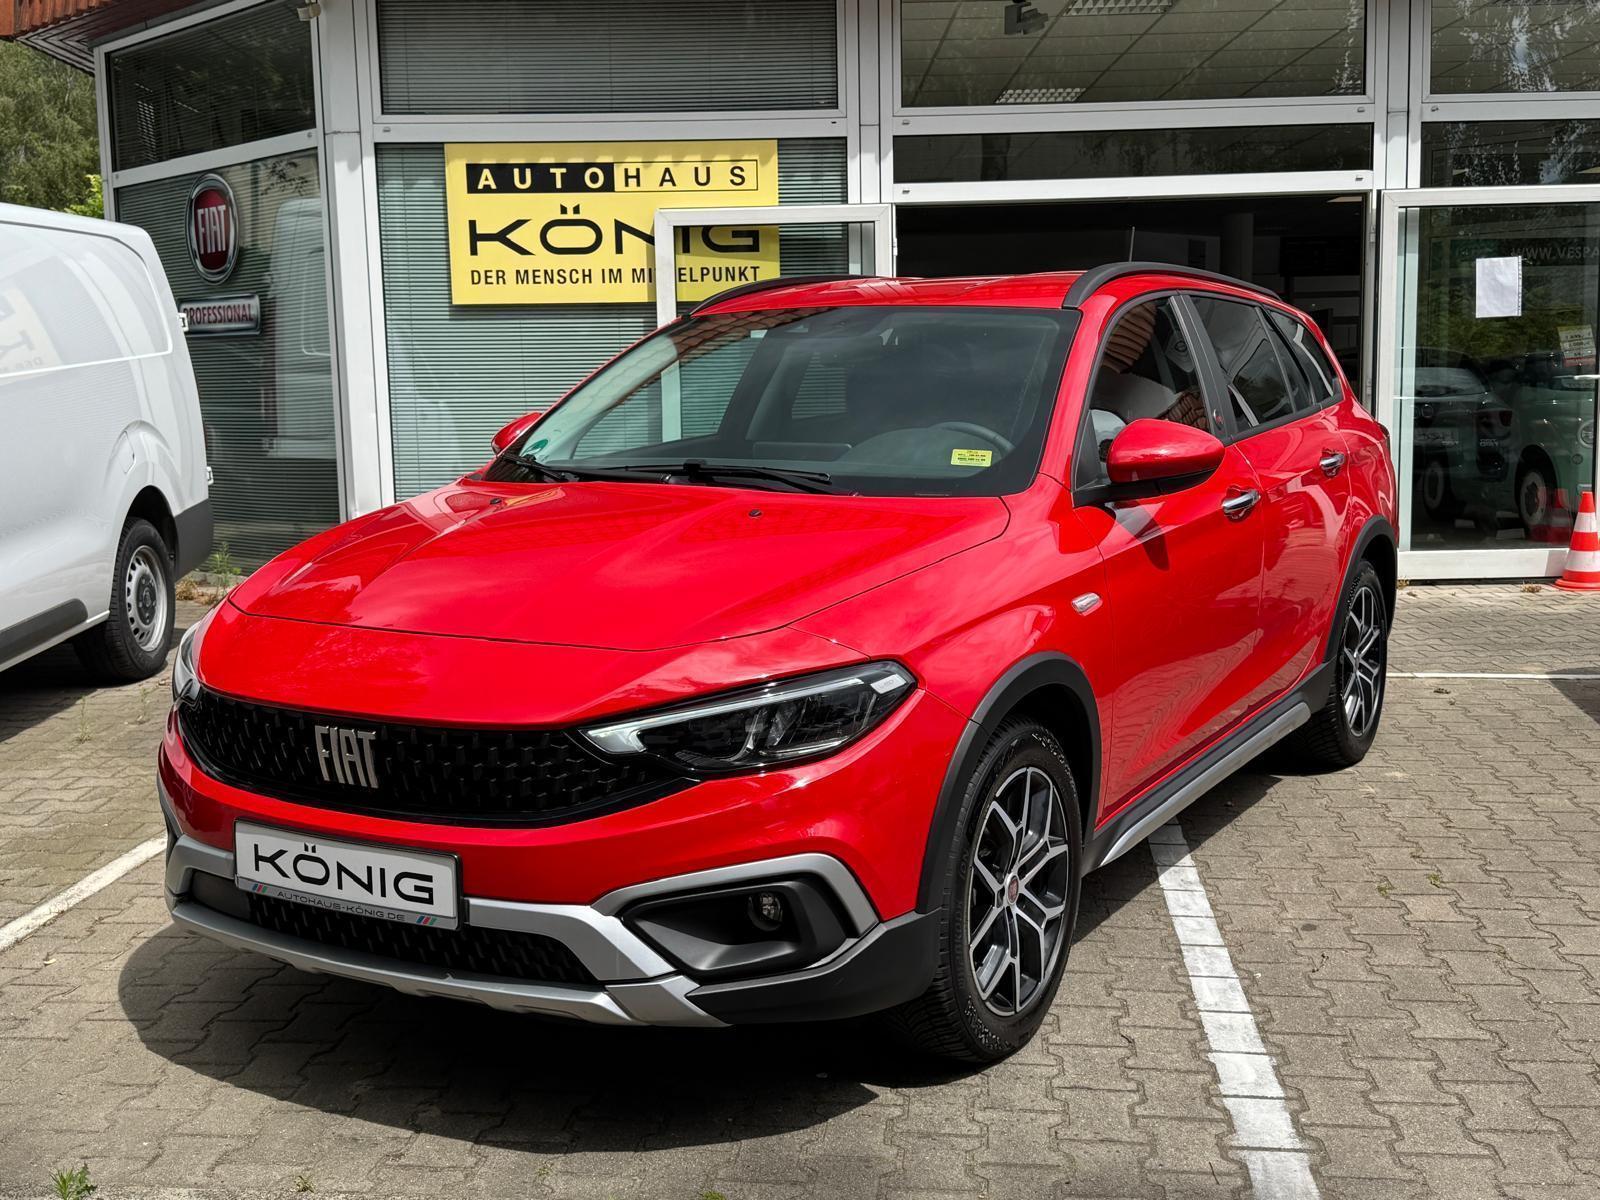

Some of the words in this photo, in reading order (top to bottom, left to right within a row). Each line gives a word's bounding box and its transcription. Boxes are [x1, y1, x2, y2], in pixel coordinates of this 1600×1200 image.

[198, 204, 226, 254] FIAT
[471, 268, 506, 285] DER
[515, 267, 593, 285] MENSCH
[601, 267, 623, 284] IM
[632, 265, 760, 284] MIELPUNKT
[314, 725, 379, 789] FIAT
[253, 842, 434, 906] KÖNIG
